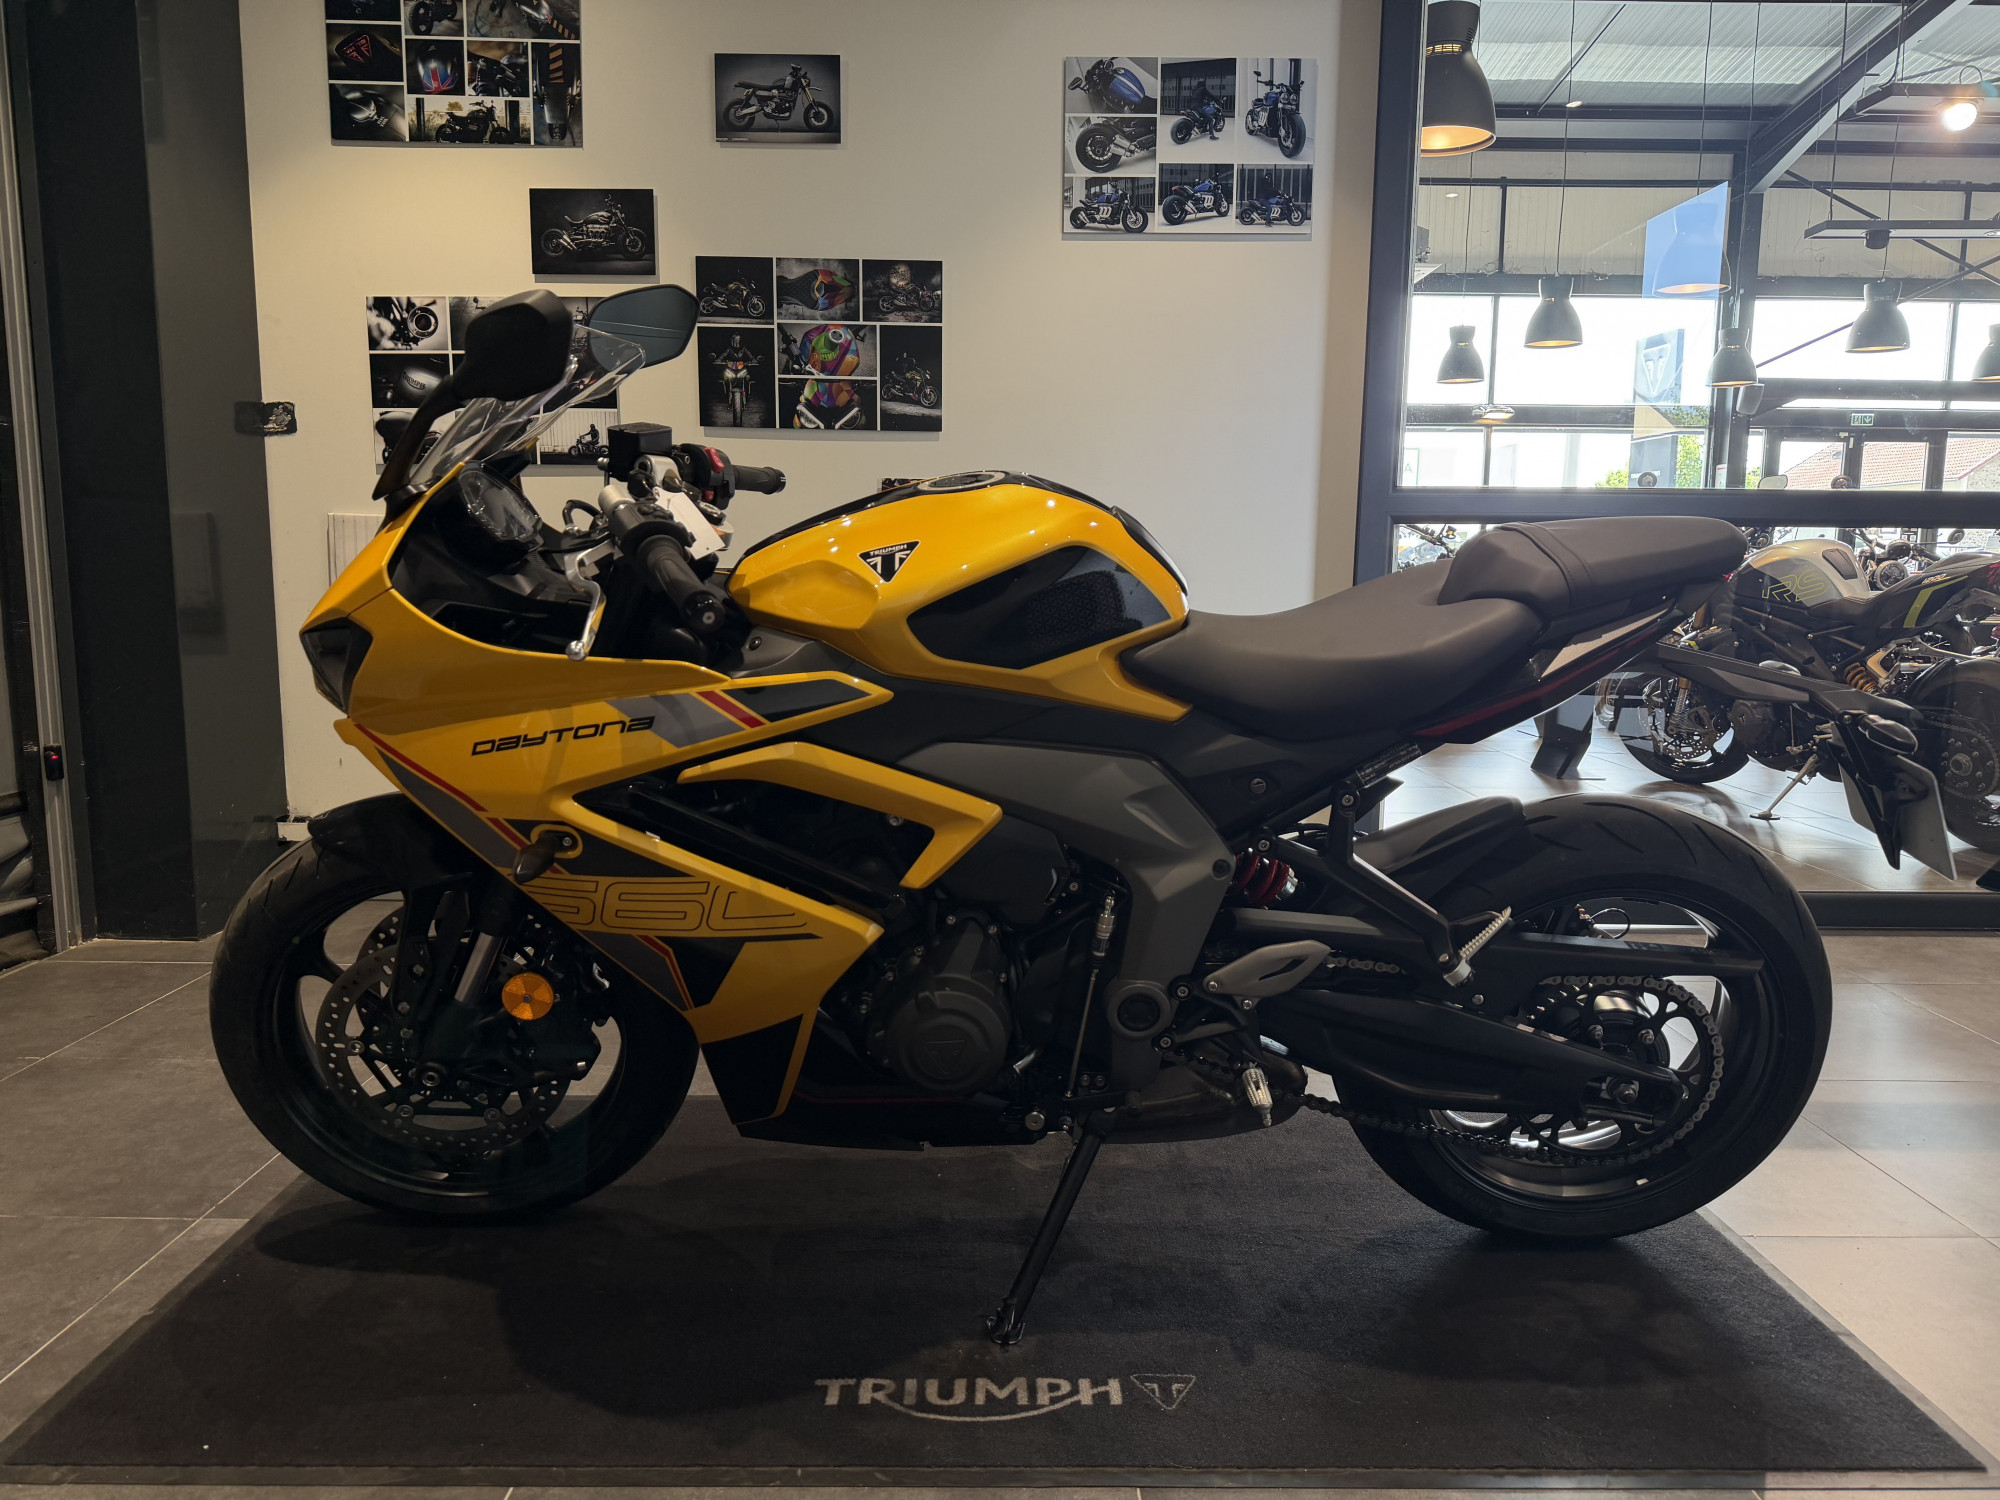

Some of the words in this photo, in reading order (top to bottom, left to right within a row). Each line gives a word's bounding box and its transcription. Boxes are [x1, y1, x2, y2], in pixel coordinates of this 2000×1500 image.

[869, 544, 908, 556] TRIUMPH
[1761, 566, 1832, 603] RS
[471, 715, 656, 756] DAYTONA
[815, 1377, 1123, 1421] TRIUMPH
